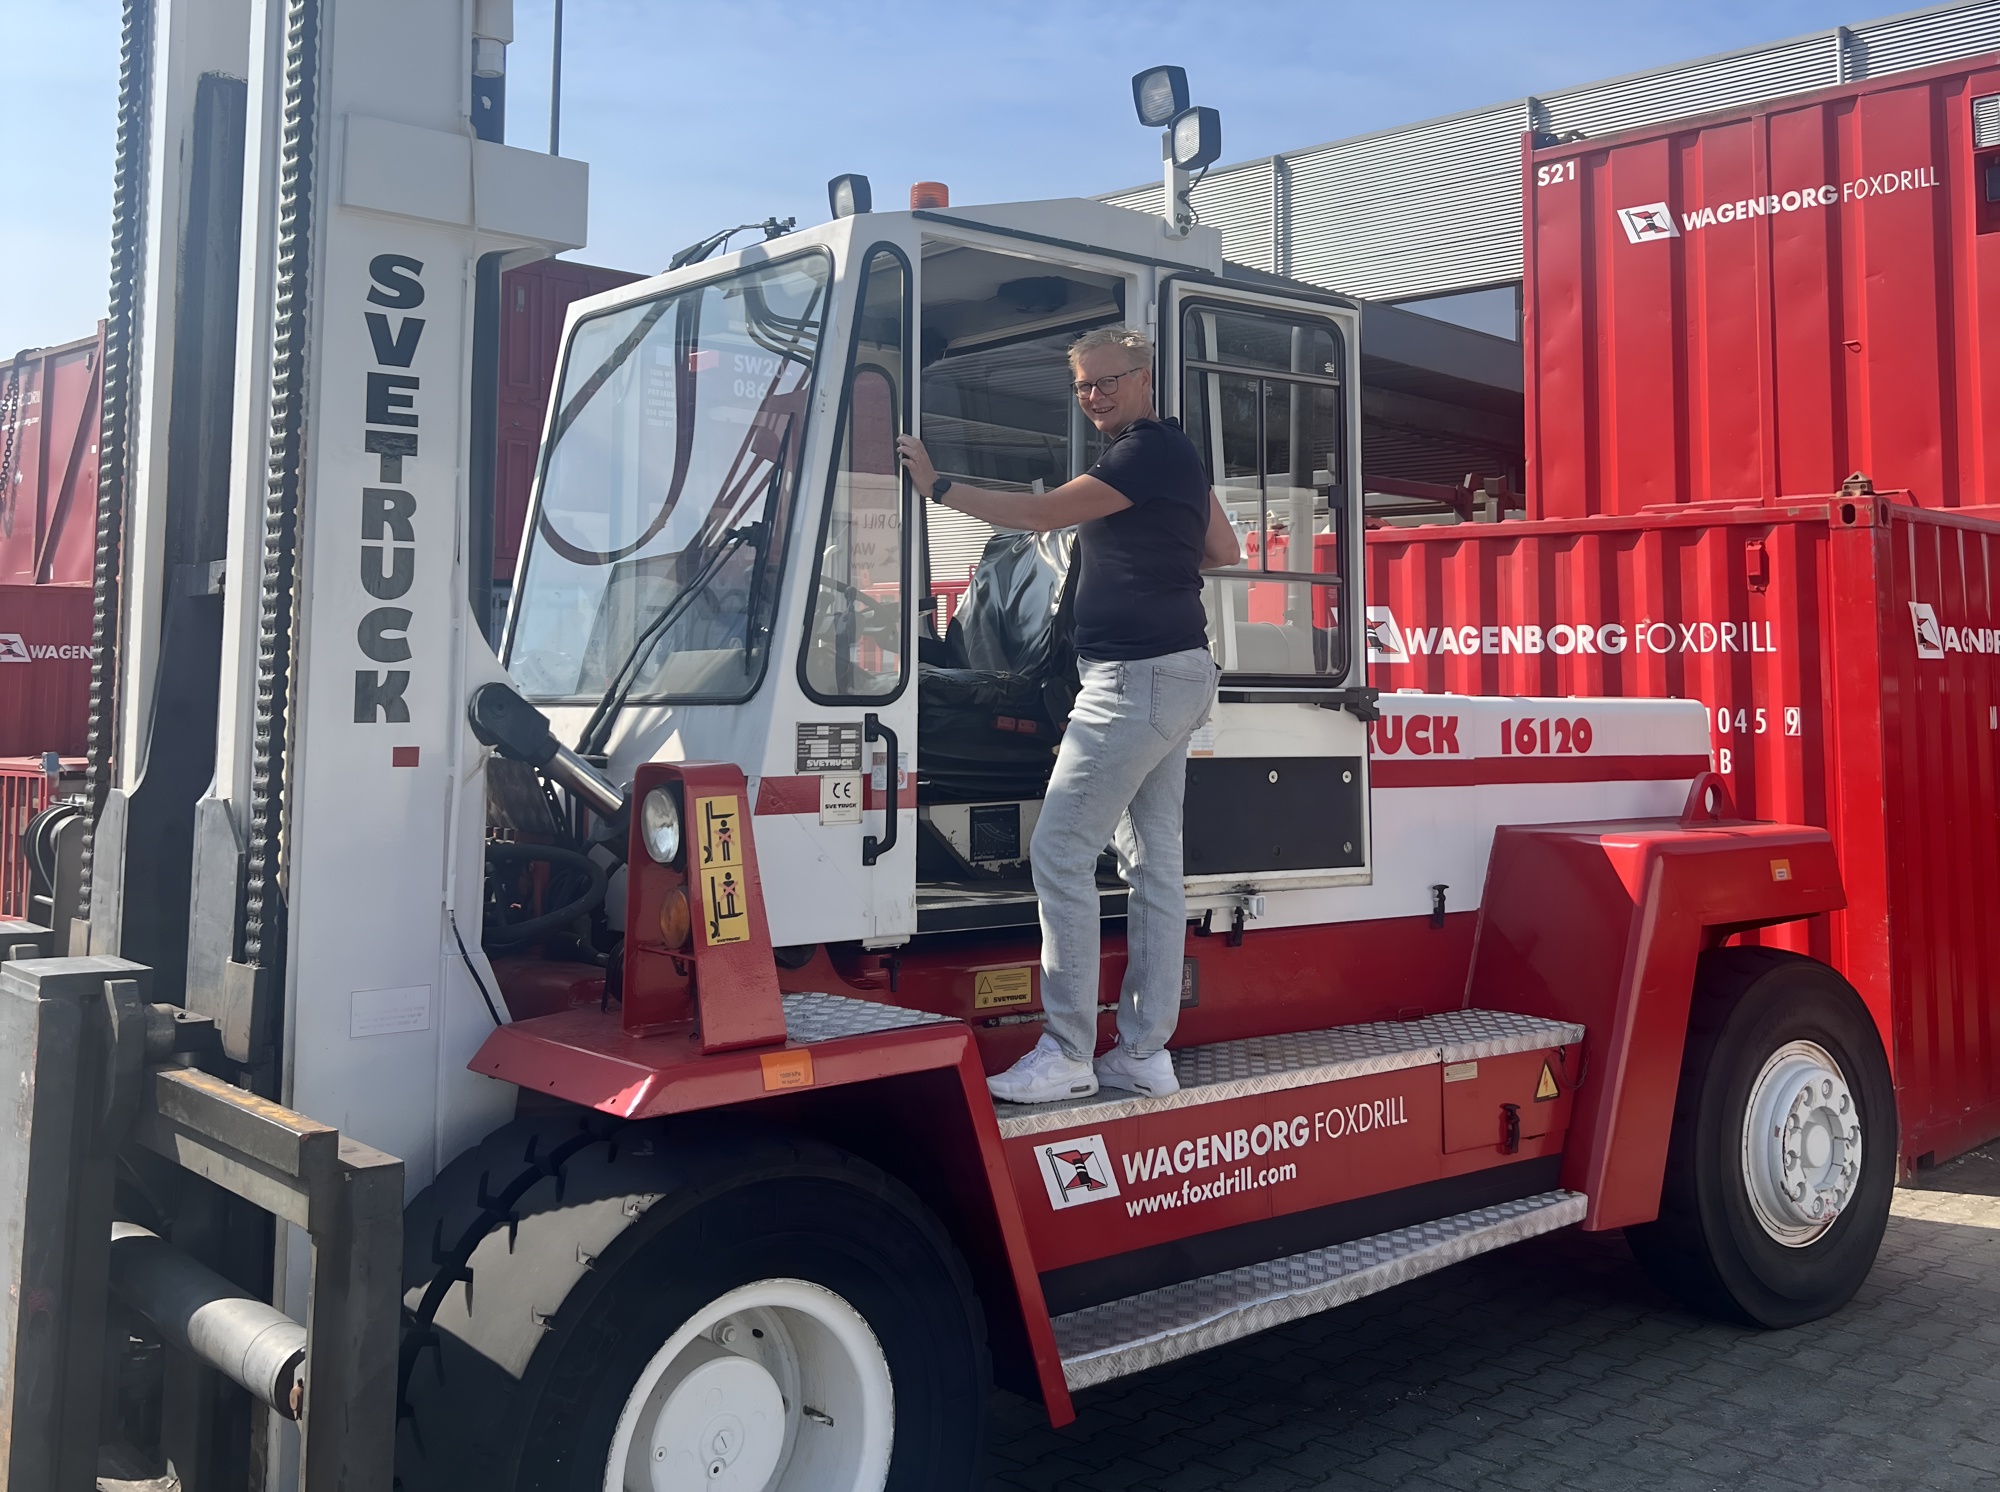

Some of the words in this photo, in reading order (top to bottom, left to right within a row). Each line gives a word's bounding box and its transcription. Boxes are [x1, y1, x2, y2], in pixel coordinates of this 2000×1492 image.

[1537, 161, 1575, 187] S21
[1681, 184, 1839, 232] WAGENBORG
[1843, 166, 1940, 203] FOXDRILL
[353, 253, 427, 724] SVETRUCK
[1405, 623, 1628, 655] WAGENBORG
[1636, 620, 1777, 654] FOXDRILL
[1501, 717, 1593, 755] 16120
[1786, 709, 1798, 734] 9
[806, 758, 854, 768] SVETRUCK
[833, 782, 852, 799] CE
[993, 994, 1028, 1003] SVETRUCK
[1121, 1115, 1311, 1185] WAGENBORG
[1314, 1095, 1408, 1142] FOXDRILL
[1125, 1162, 1298, 1218] www.foxdrill.com
